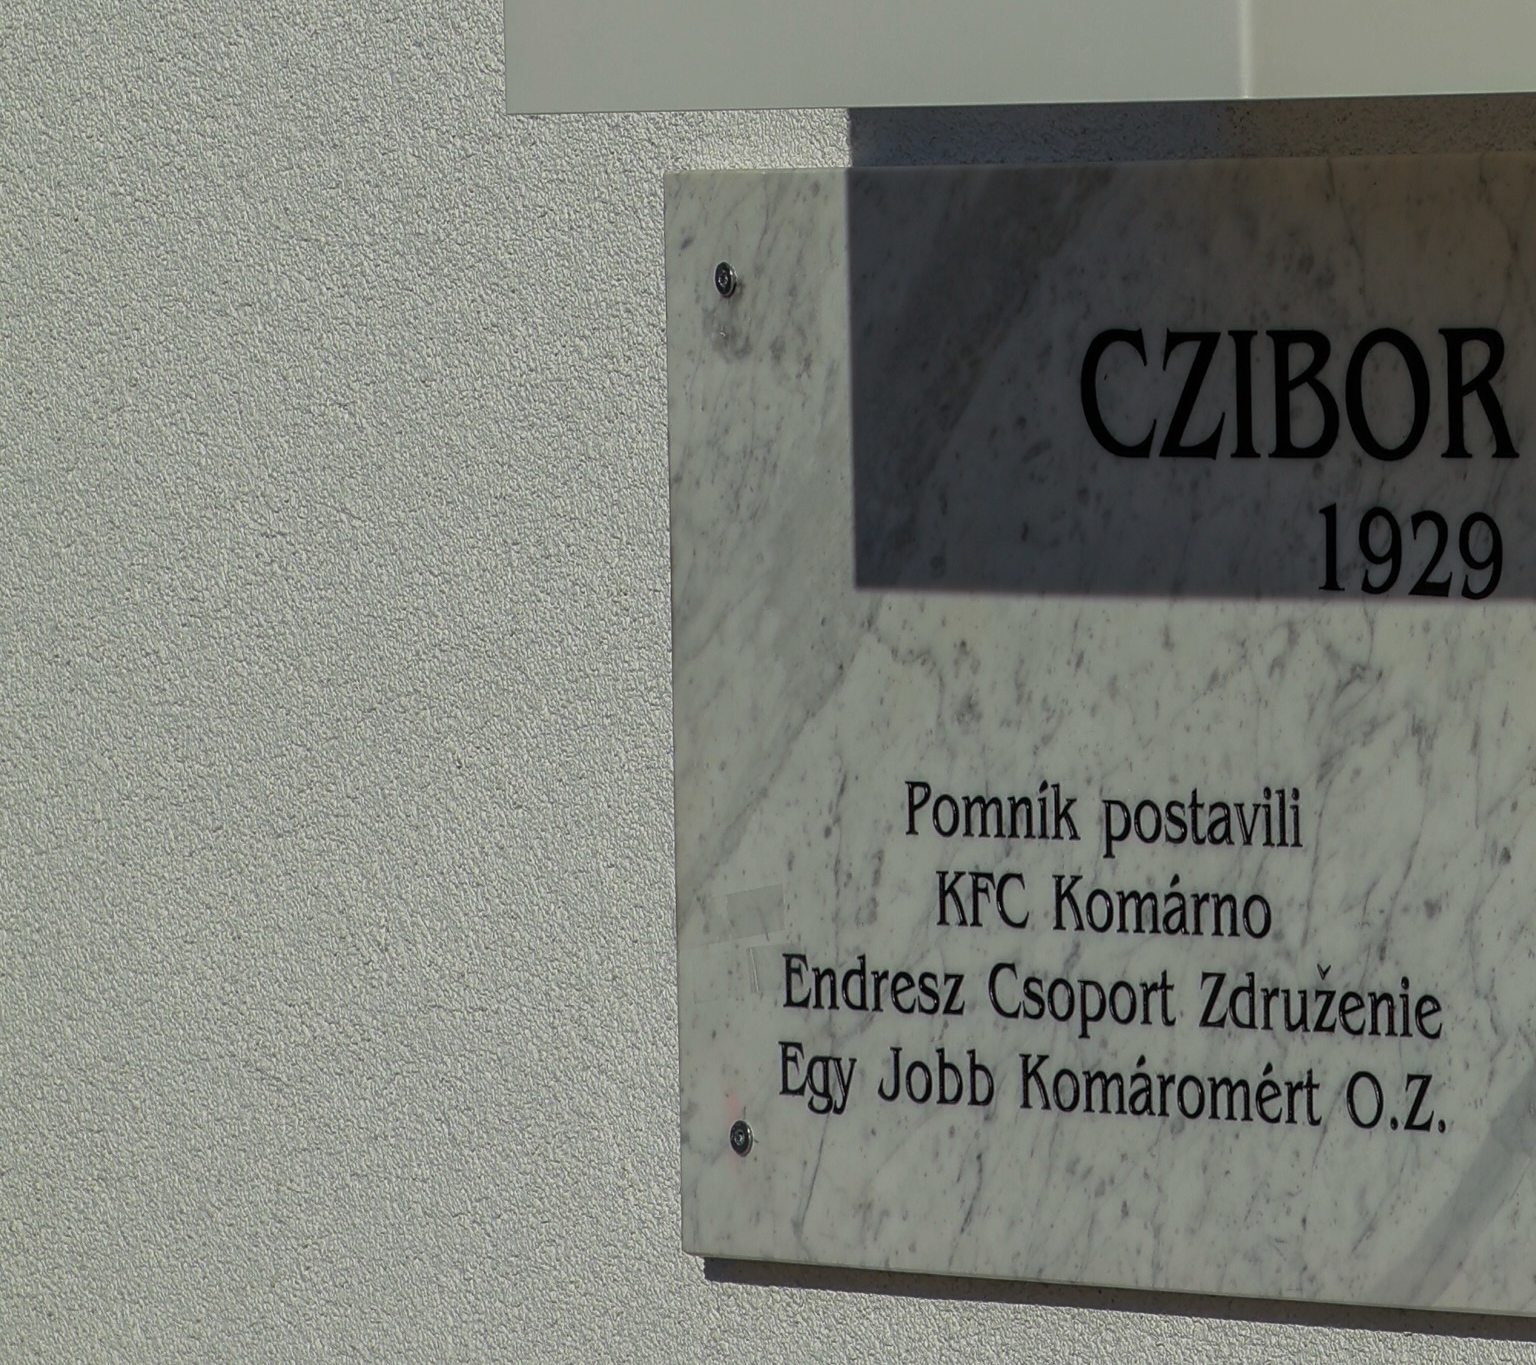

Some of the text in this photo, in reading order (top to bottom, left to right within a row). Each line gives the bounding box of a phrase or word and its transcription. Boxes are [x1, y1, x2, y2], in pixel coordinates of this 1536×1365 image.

[1079, 327, 1519, 463] CZIBOR
[1317, 502, 1504, 600] 1929
[904, 780, 1303, 859] Pomník postavili
[936, 871, 1273, 940] KFC Komárno
[782, 953, 1443, 1040] Endresz Csoport Združenie
[779, 1041, 1447, 1134] Egy Jobb Komáromért O.Z.
